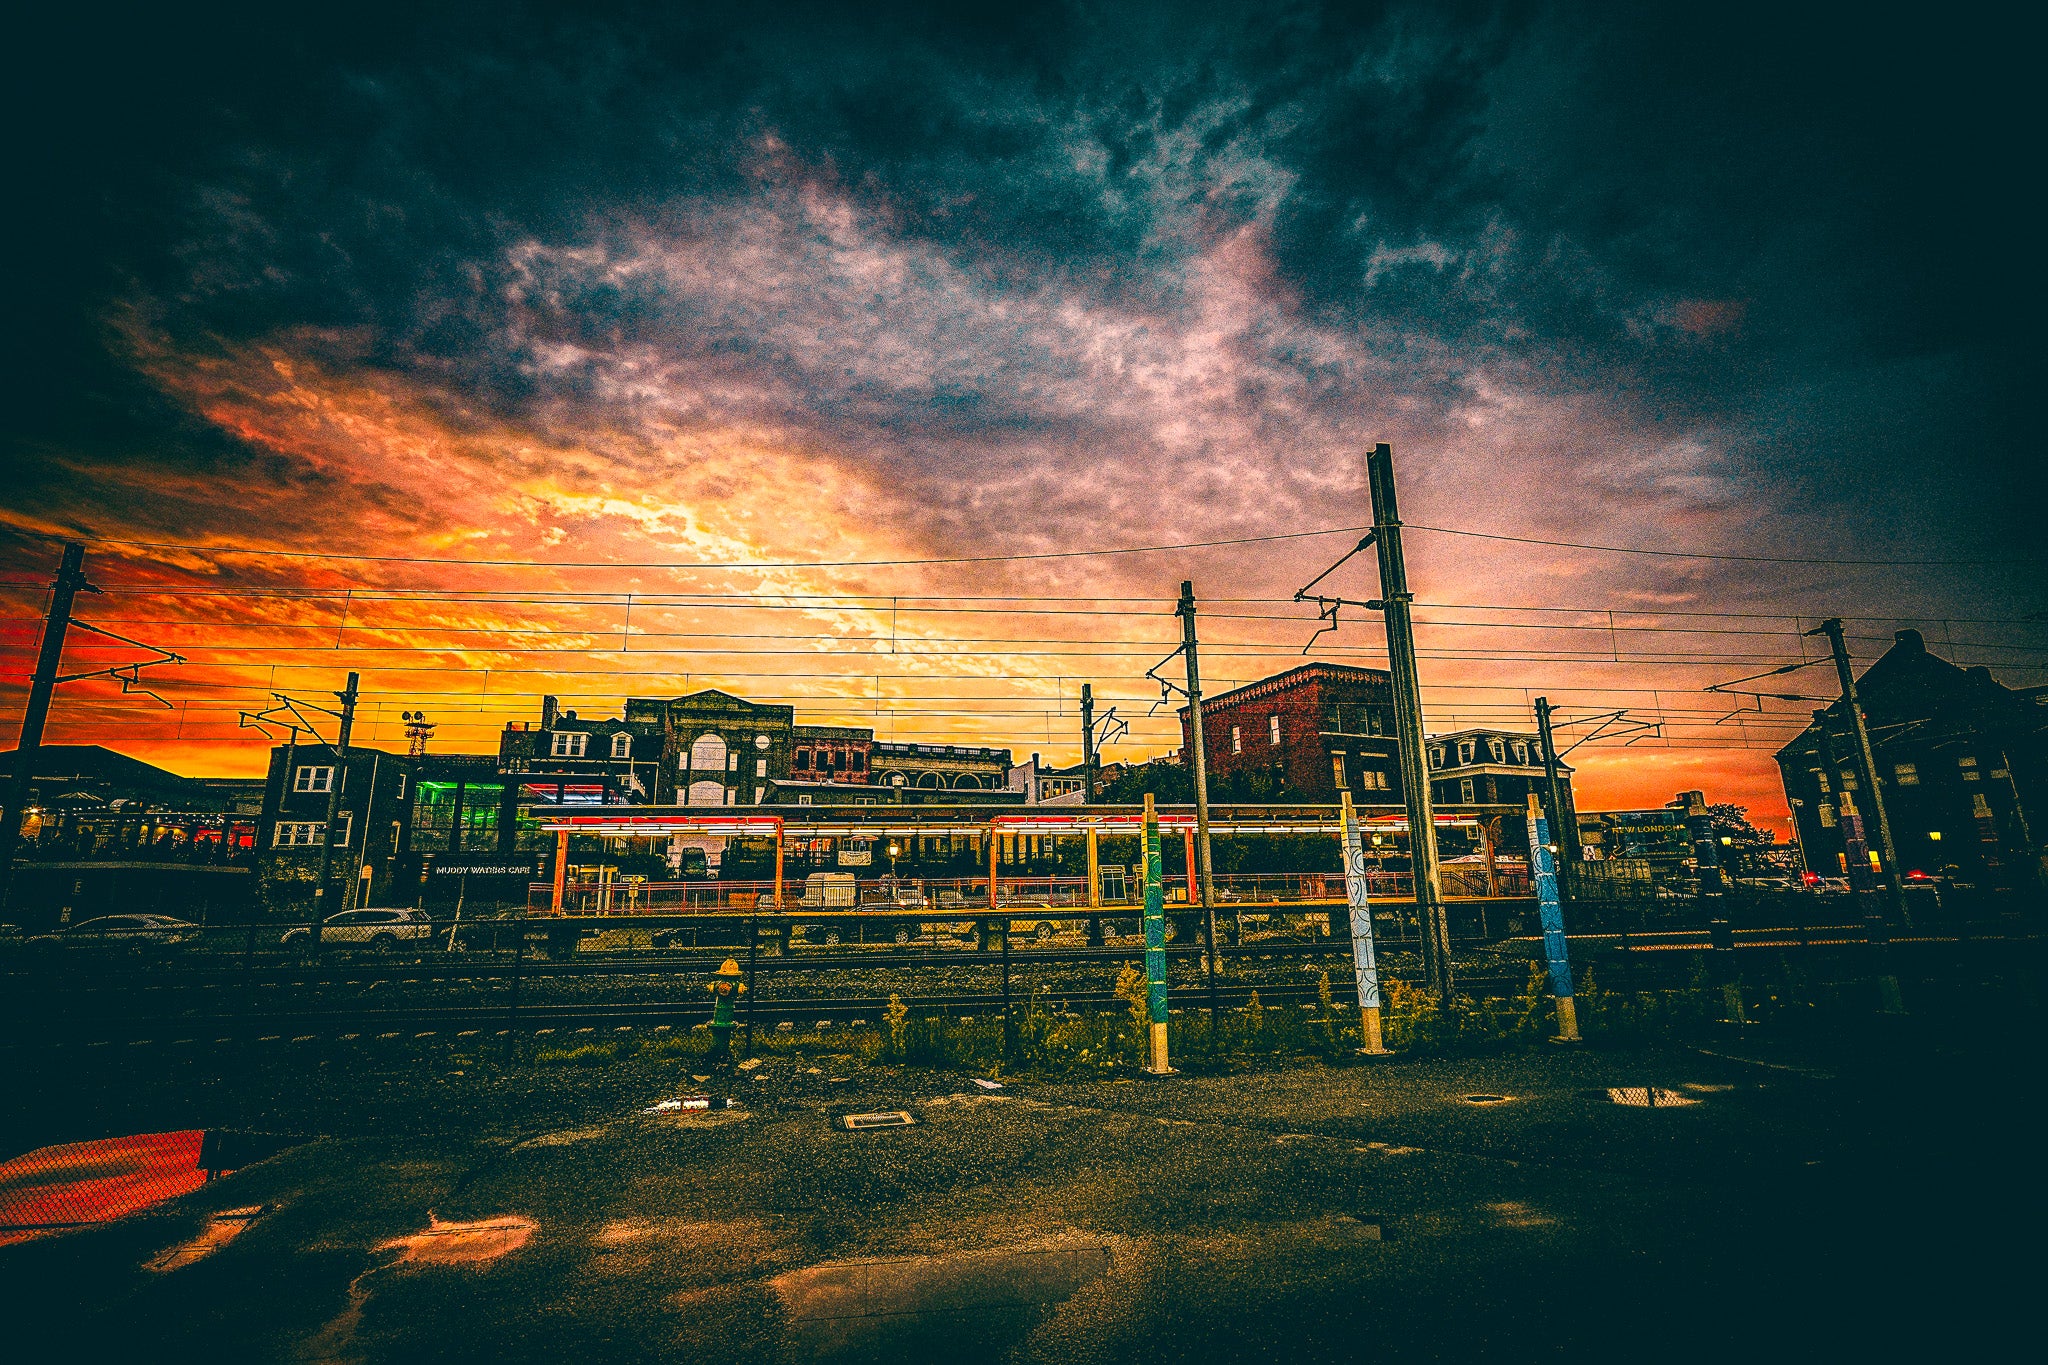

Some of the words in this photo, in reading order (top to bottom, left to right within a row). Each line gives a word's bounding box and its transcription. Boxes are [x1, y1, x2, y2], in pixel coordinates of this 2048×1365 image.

[1637, 824, 1681, 833] LONDON
[436, 866, 469, 875] MUDDY
[470, 866, 506, 875] WATERS
[508, 866, 531, 874] CAFE
